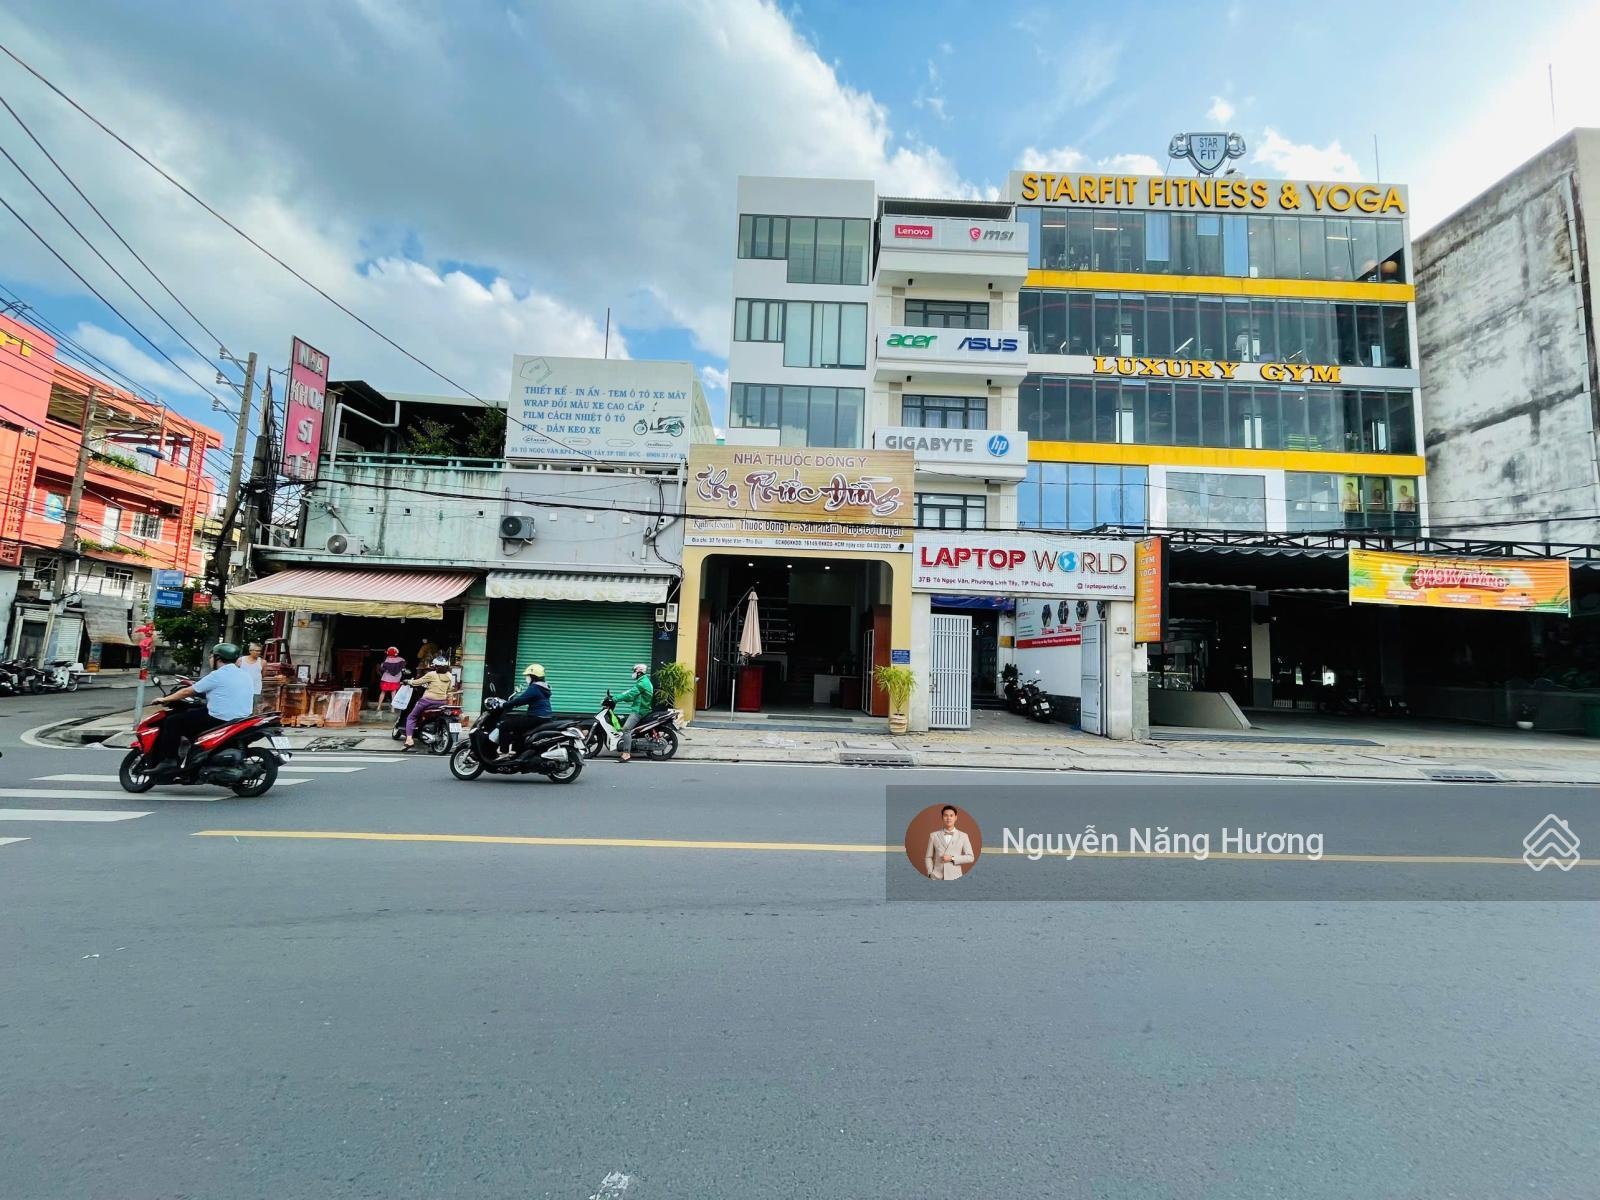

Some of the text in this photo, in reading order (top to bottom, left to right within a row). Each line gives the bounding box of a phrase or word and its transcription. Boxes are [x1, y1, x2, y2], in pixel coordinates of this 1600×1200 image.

[1199, 136, 1219, 149] STAR
[1201, 148, 1217, 160] FIT
[1022, 172, 1407, 214] STARFIT FITNESS & YOGA
[897, 226, 930, 236] Lenovo
[886, 333, 938, 349] acer
[957, 337, 1018, 352] ASUS
[1092, 355, 1342, 384] LUXURY GYM
[290, 378, 324, 413] KHOA
[575, 388, 585, 396] IN
[608, 390, 627, 398] TEM
[653, 391, 665, 399] XE
[523, 399, 549, 408] WRAP
[592, 402, 604, 410] XE
[607, 403, 625, 411] CAO
[523, 411, 545, 420] FILM
[588, 426, 601, 435] XE
[885, 435, 974, 452] GIGABYTE
[992, 435, 1007, 455] hp
[766, 452, 812, 467] THUỐC
[815, 454, 854, 468] ĐÔNG
[858, 457, 868, 468] Y
[920, 546, 1128, 574] LAPTOP WORLD
